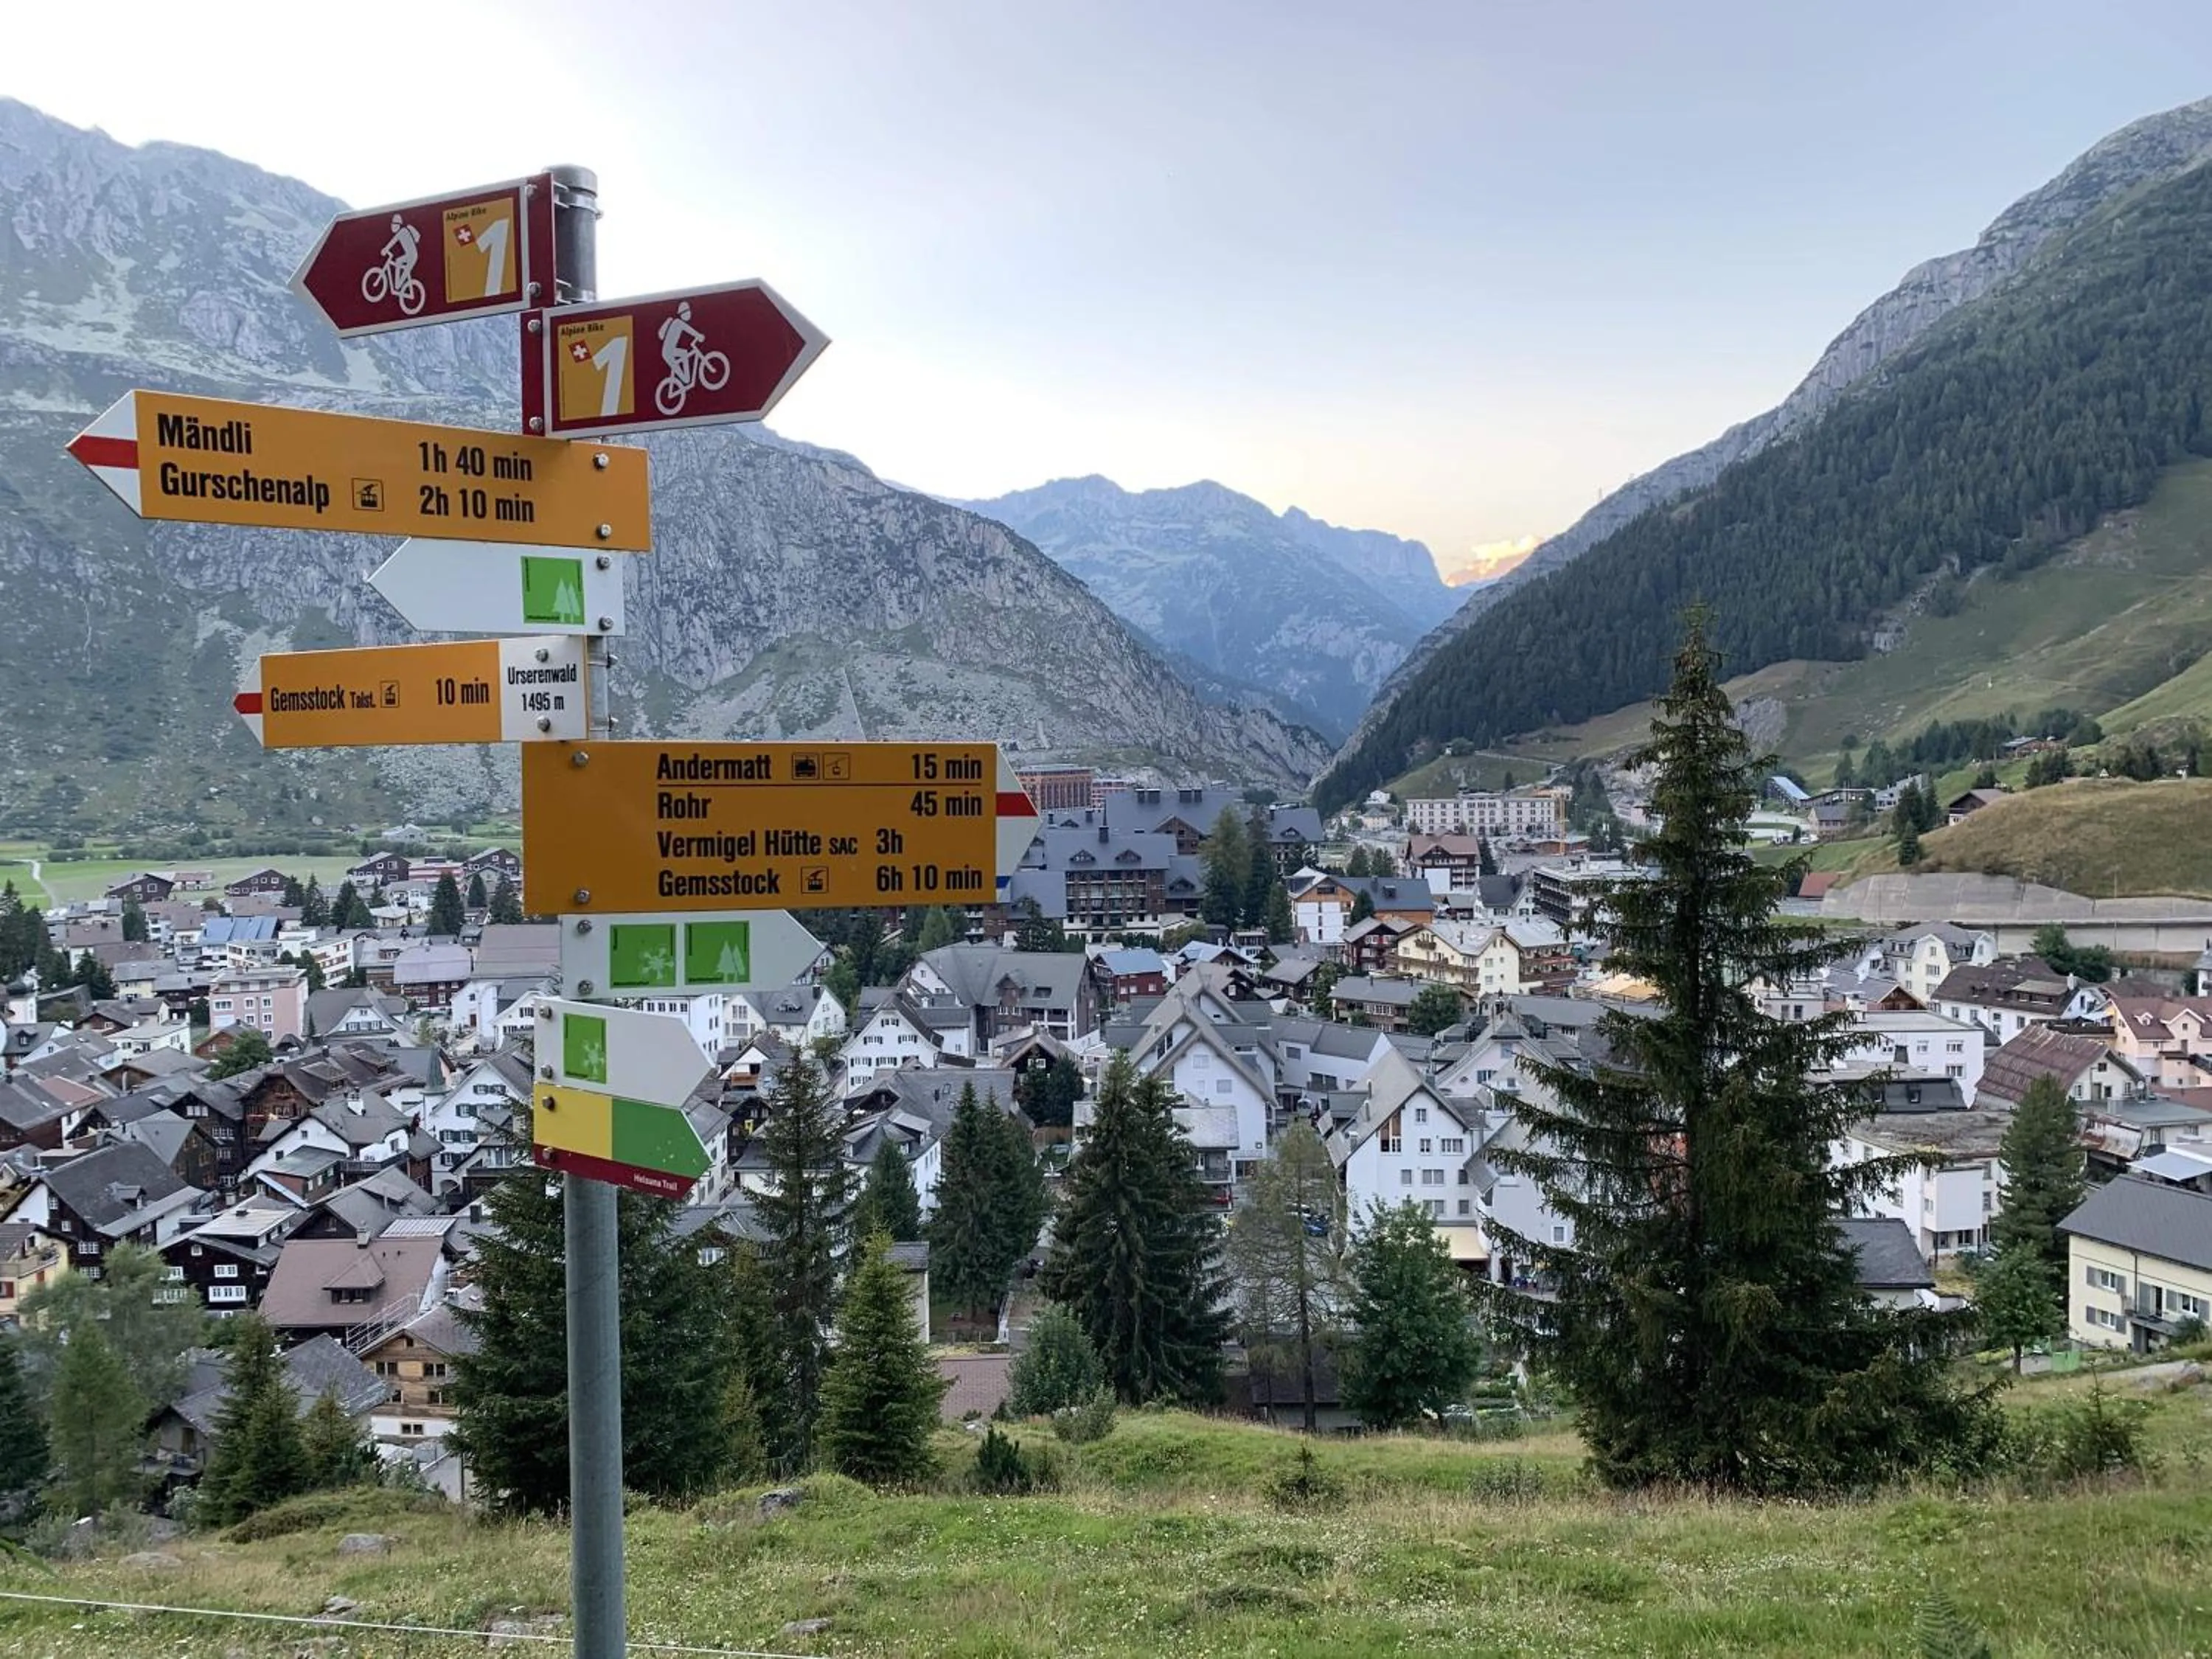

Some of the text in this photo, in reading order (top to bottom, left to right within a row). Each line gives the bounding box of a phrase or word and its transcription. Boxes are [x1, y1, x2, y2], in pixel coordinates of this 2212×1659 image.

[471, 207, 487, 216] Bike
[476, 218, 509, 296] 1
[561, 323, 605, 337] Alpine Bike
[592, 336, 627, 416] 1
[158, 413, 532, 481] Mändli 1h 40 min
[161, 462, 534, 522] Gurschenalp 2h 10 min
[508, 664, 577, 684] Urserenwald
[271, 678, 489, 712] Gemsstock Talst. 10 min
[522, 692, 564, 711] 1495 m
[657, 754, 981, 779] Andermatt 15 min
[658, 791, 981, 818] Rohr 45 min
[658, 829, 902, 863] Vermigel Hütte SAC 3h
[658, 865, 982, 897] Gemsstock 6h 10 min
